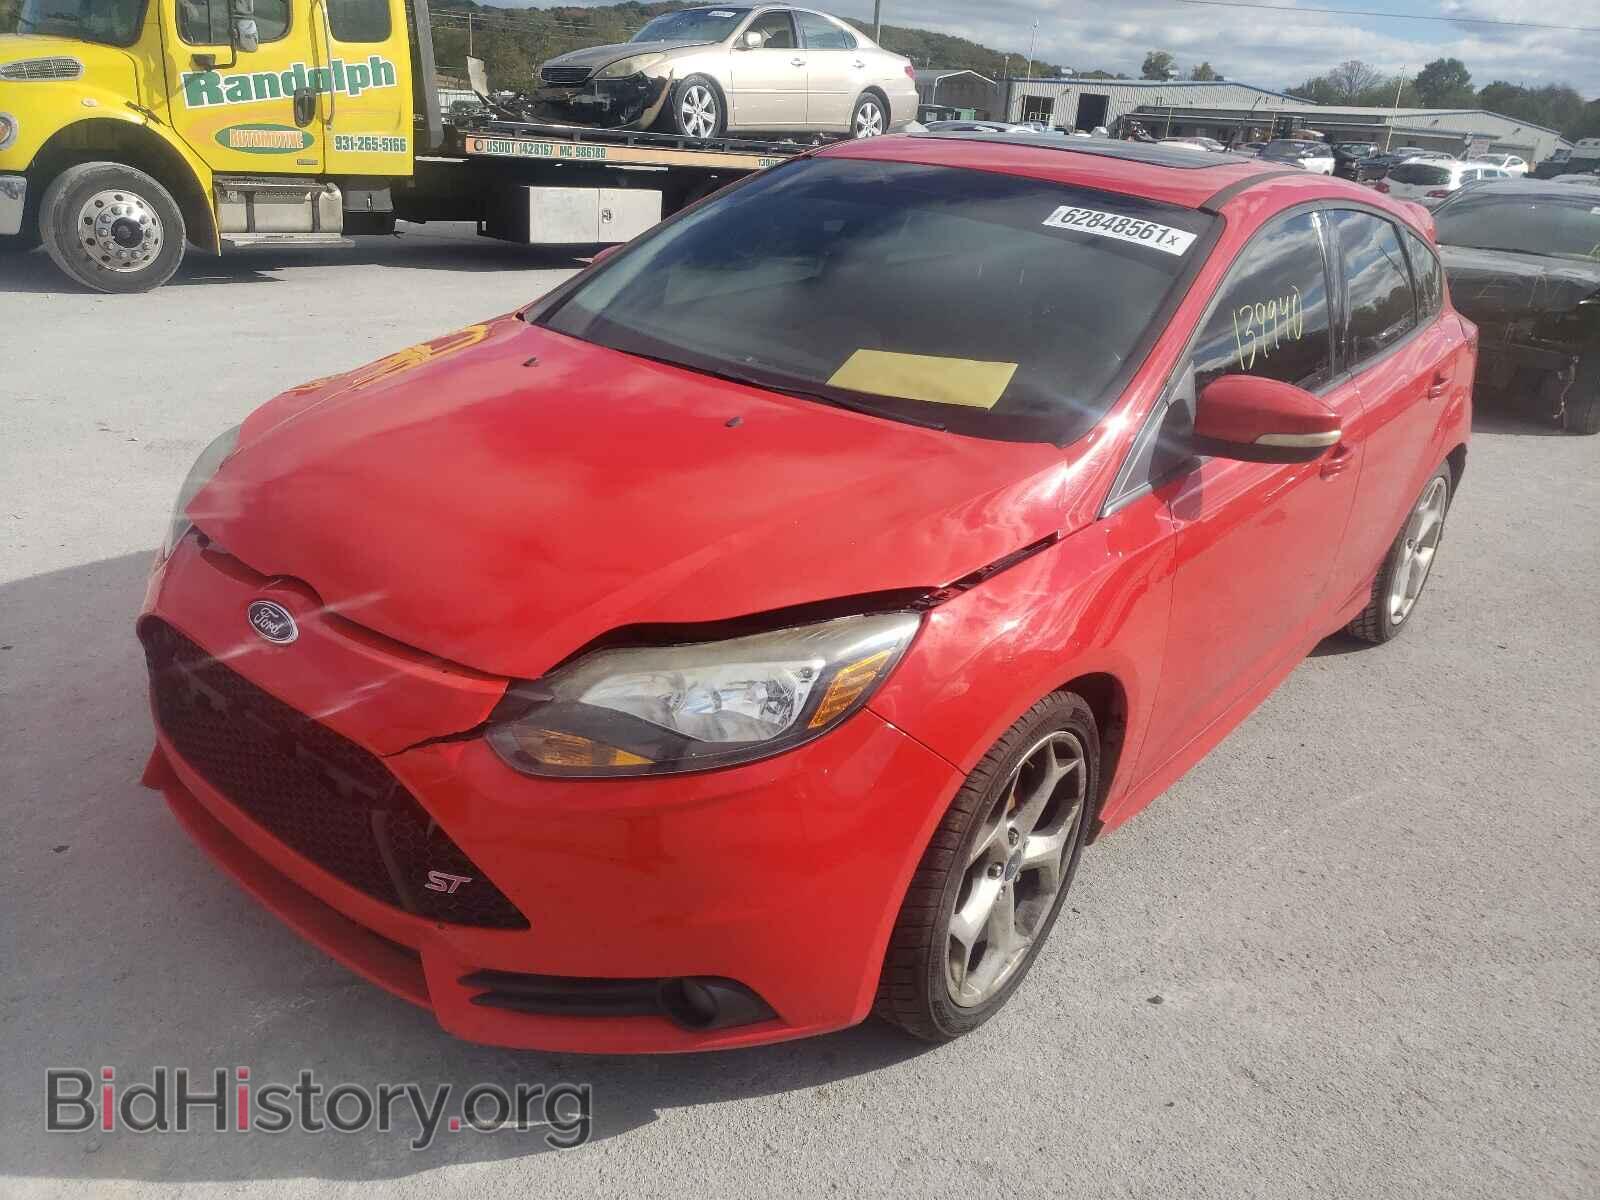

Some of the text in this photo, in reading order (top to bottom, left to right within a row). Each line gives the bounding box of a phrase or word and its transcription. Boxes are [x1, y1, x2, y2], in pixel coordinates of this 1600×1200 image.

[181, 55, 397, 108] Randolph
[335, 135, 407, 152] 931-265-5166
[486, 140, 515, 154] USDOT
[559, 145, 573, 157] MC
[1232, 284, 1303, 370] 139940
[253, 606, 288, 635] Ford
[424, 870, 473, 894] ST
